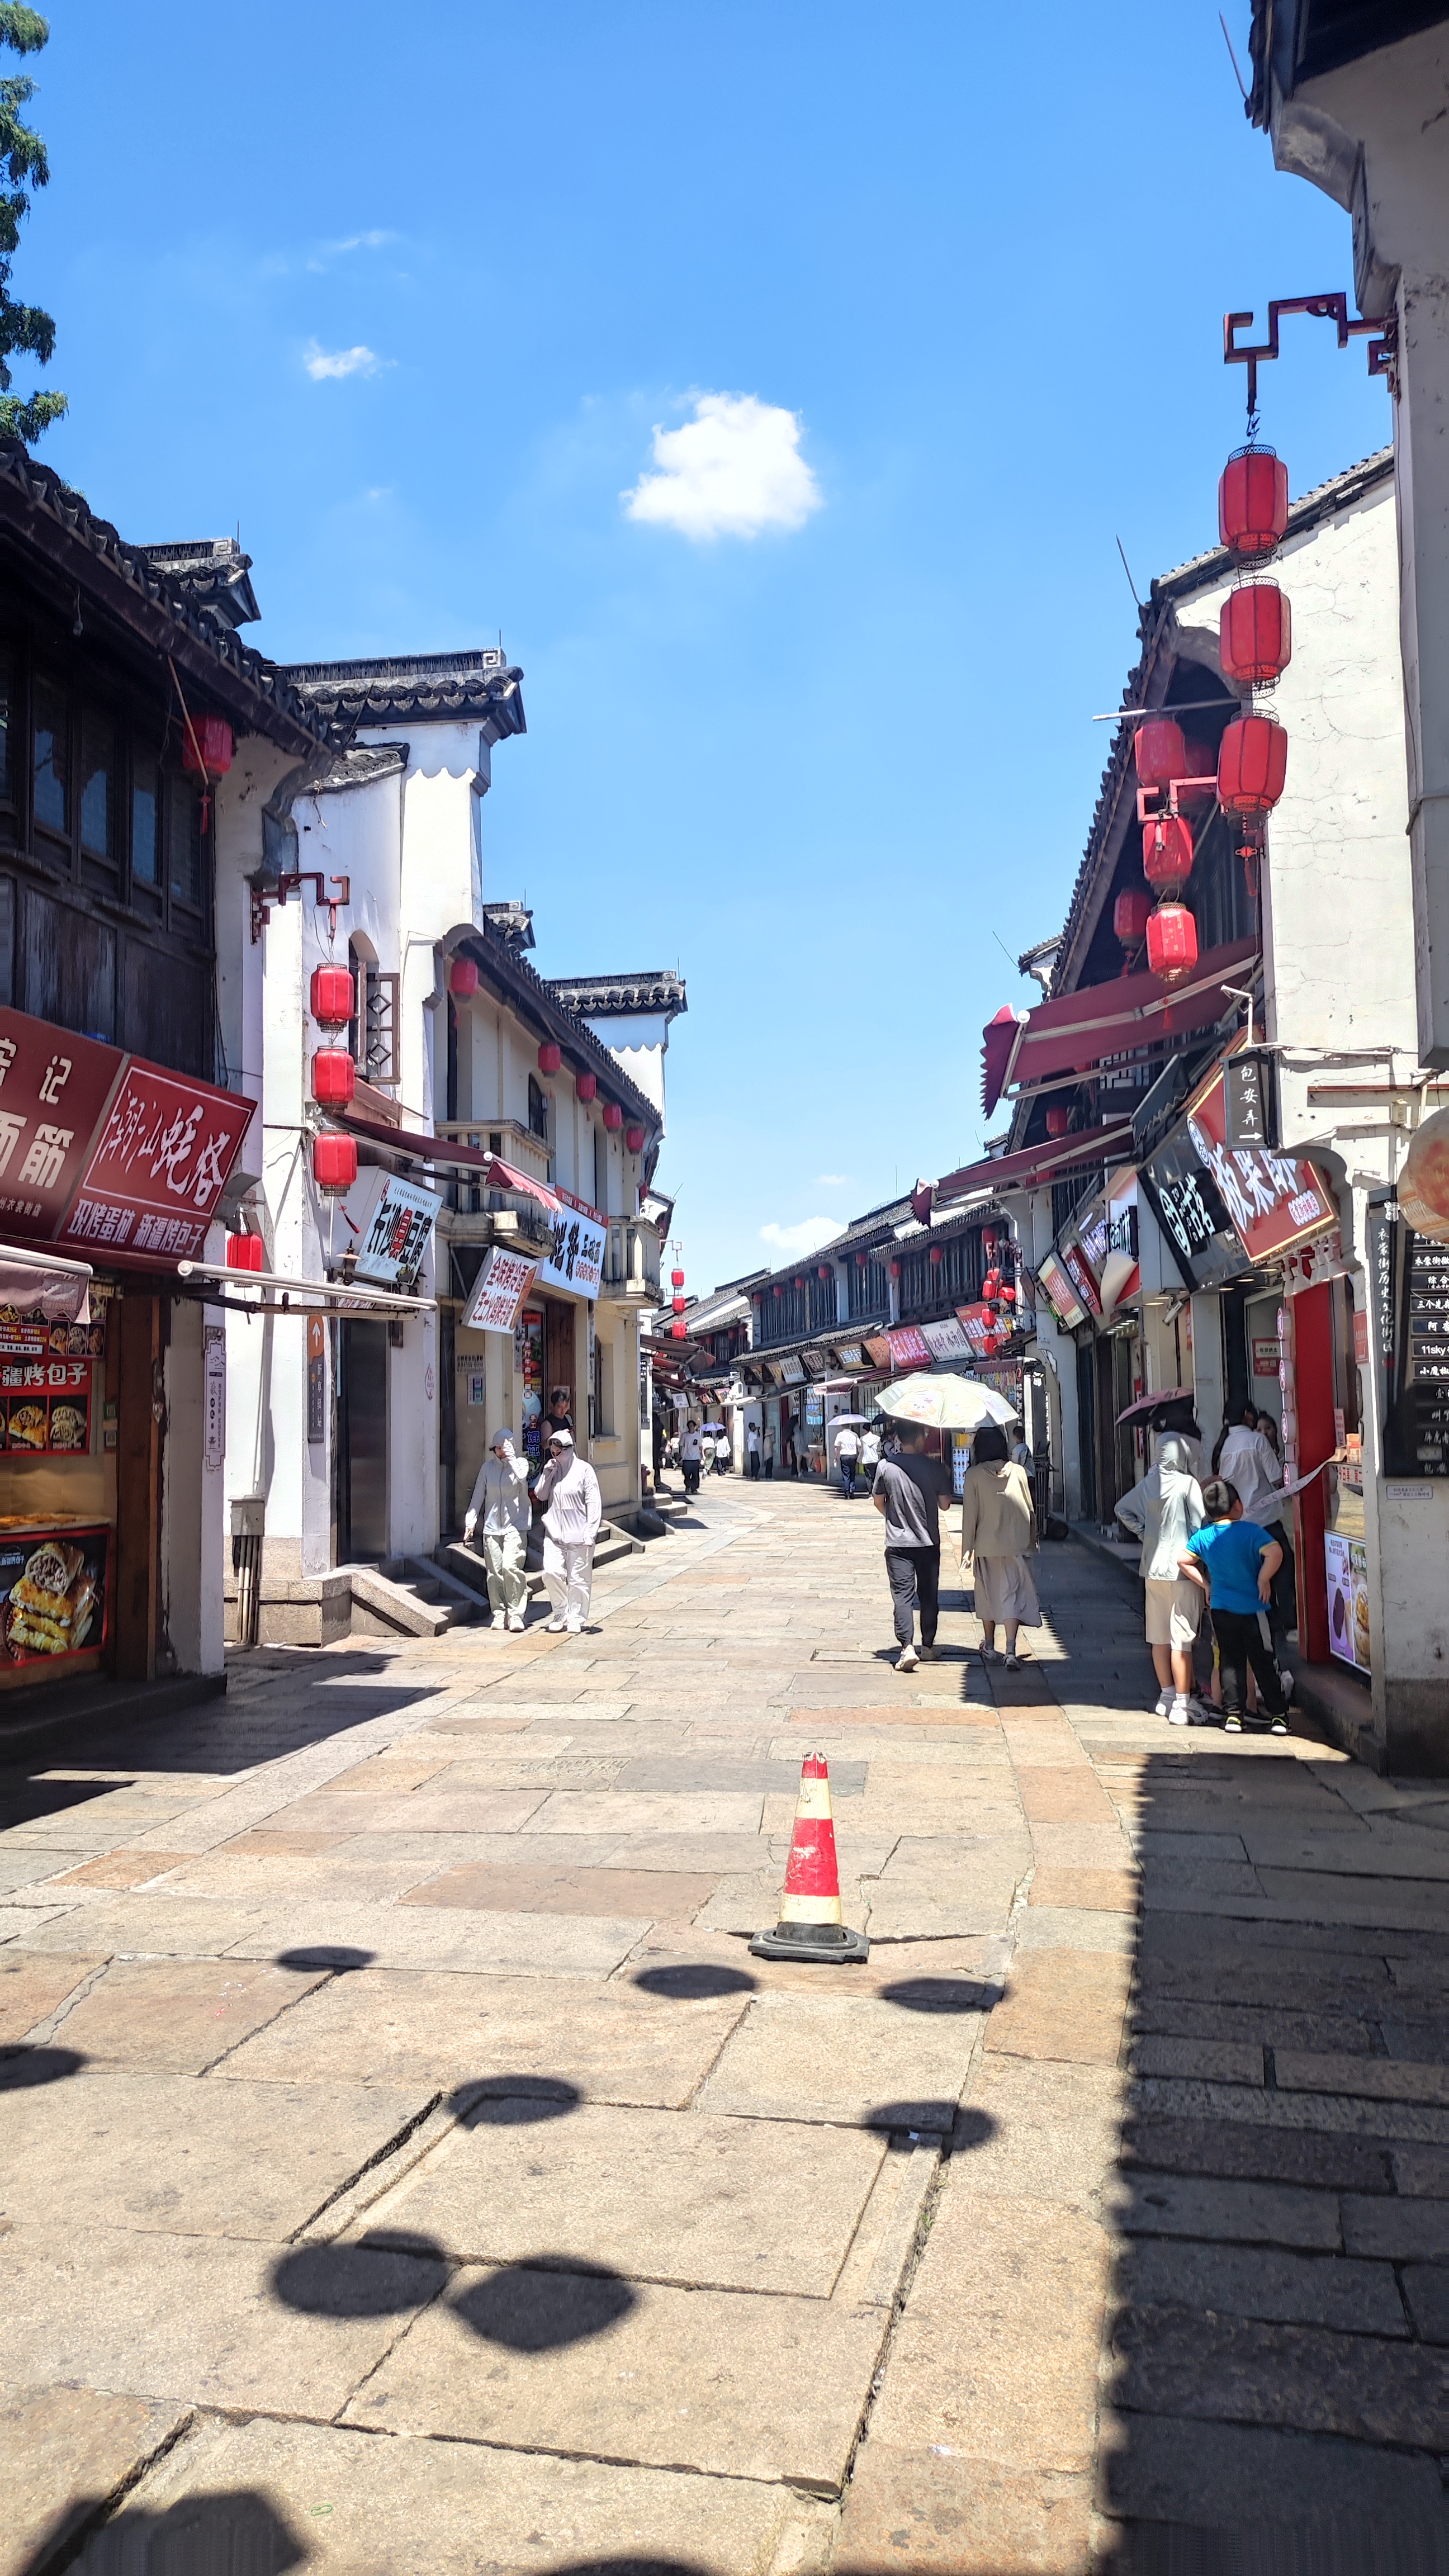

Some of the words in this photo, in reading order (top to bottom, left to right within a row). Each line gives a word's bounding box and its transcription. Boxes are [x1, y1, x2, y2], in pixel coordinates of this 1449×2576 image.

[1239, 1066, 1259, 1128] 包安弄
[99, 1088, 231, 1207] 潮汕蚝烙
[67, 1199, 136, 1244] 现烤蛋挞
[132, 1213, 205, 1255] 新疆烤包子
[1178, 1172, 1216, 1240] 古茗
[1377, 1228, 1394, 1352] 衣裳街历史文化街区
[527, 1431, 541, 1456] 馄饨
